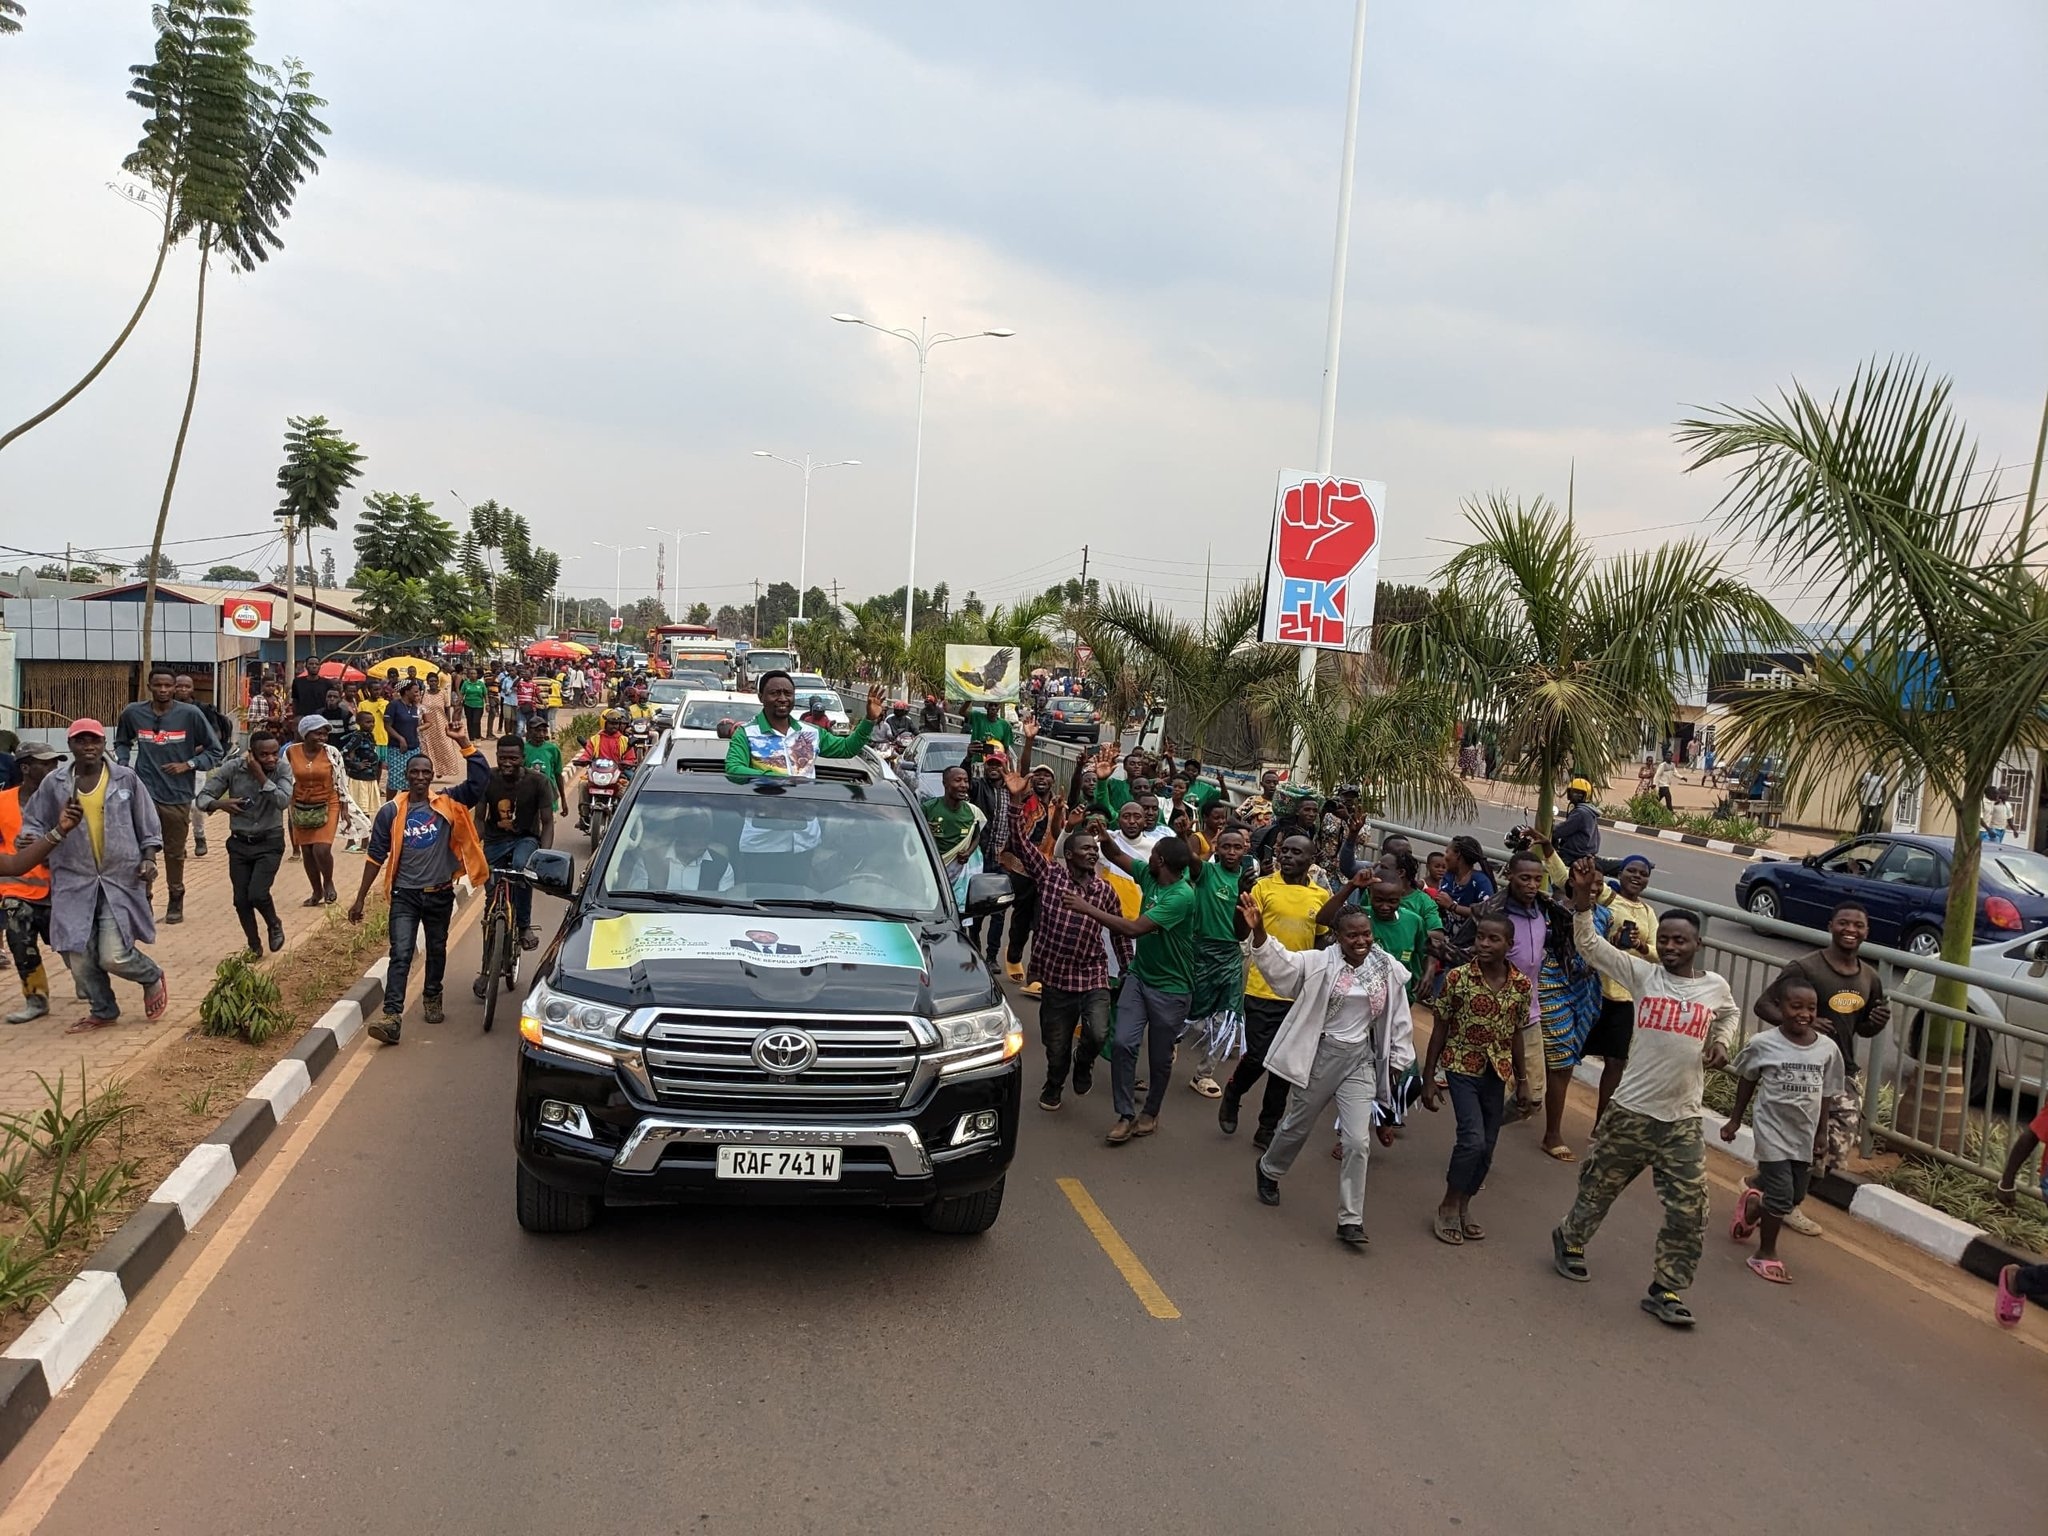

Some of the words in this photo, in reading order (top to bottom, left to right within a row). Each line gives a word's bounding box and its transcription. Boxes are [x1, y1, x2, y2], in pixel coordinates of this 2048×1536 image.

[1282, 579, 1346, 619] PK
[1279, 603, 1321, 642] 24
[171, 663, 201, 673] DIGITAL
[404, 824, 438, 838] NASA
[702, 1129, 754, 1140] LAND
[768, 1131, 857, 1142] CRUISER
[732, 1152, 774, 1174] RAF
[778, 1153, 816, 1176] 741
[822, 1154, 835, 1176] W
